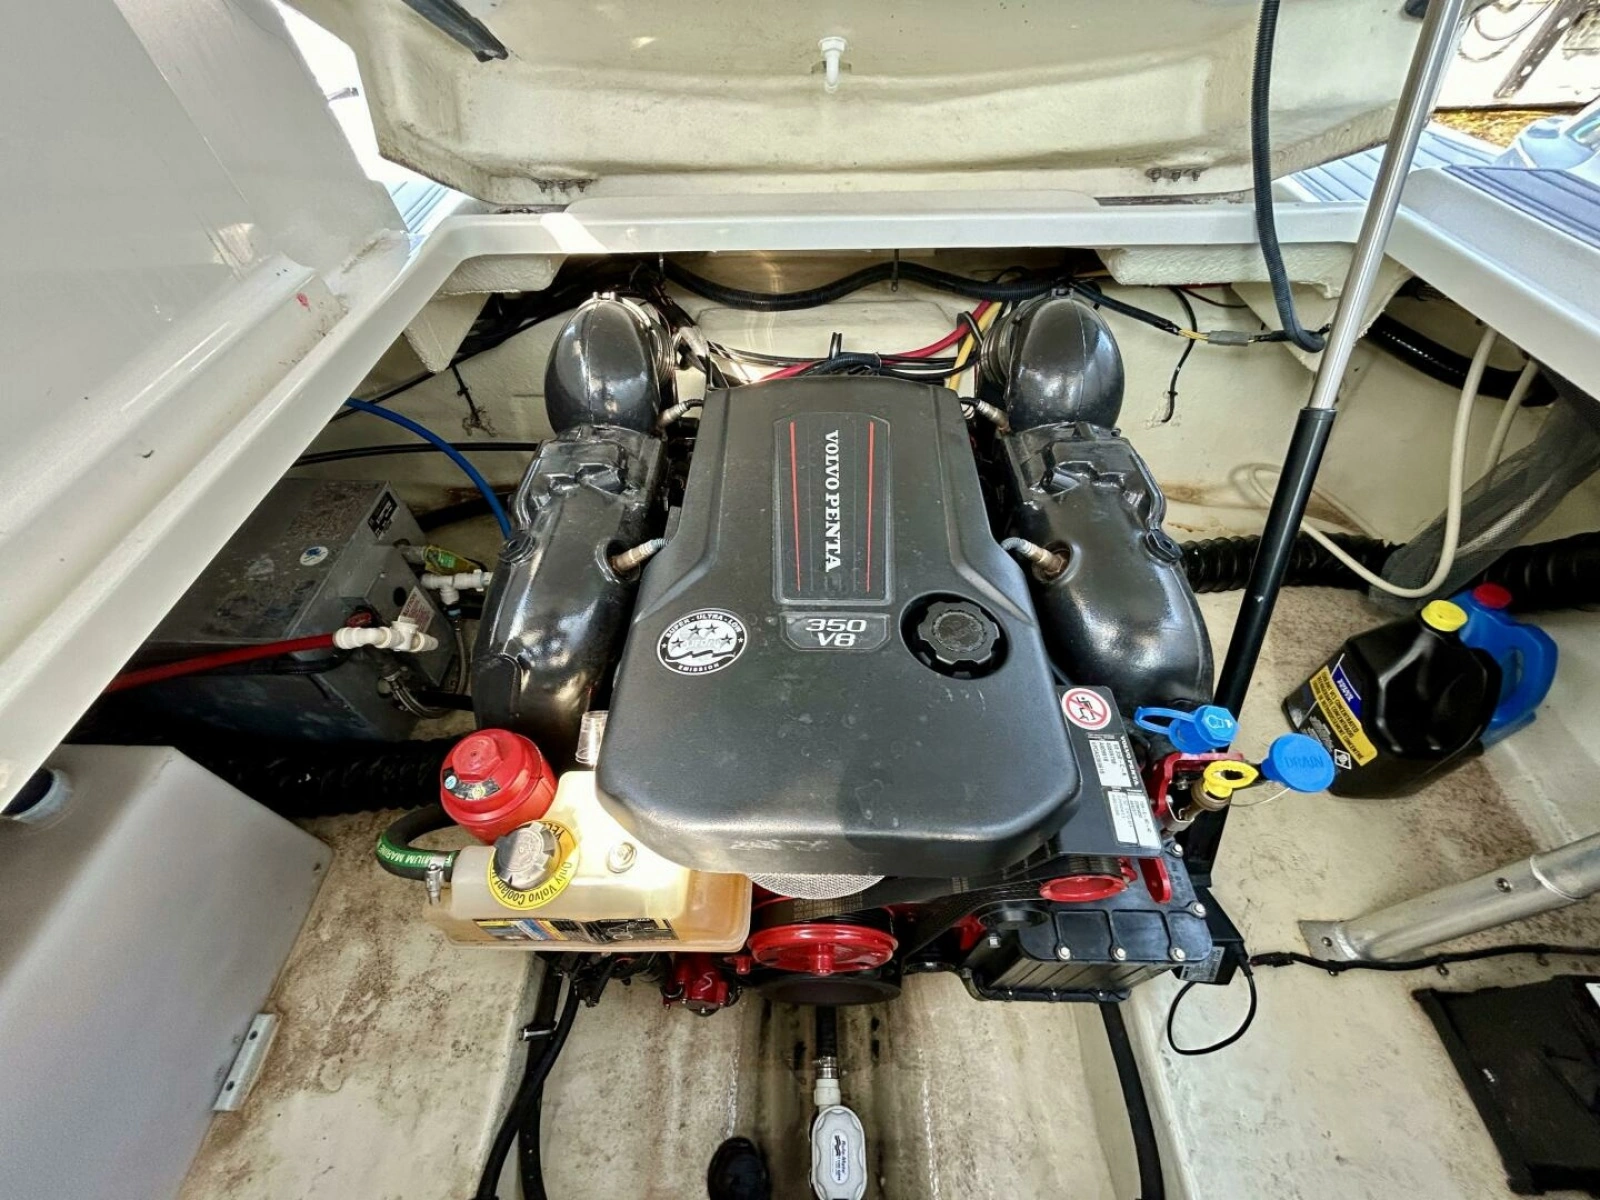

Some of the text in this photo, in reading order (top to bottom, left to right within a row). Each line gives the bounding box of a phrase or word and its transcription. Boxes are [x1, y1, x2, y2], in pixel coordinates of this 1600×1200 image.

[825, 429, 842, 573] VOLVO PENTA
[805, 618, 867, 633] 350
[816, 633, 856, 647] V8
[677, 662, 720, 673] EMISSION
[1120, 735, 1139, 787] VOLVO PENTA
[377, 844, 405, 863] MARINE
[494, 861, 573, 906] Only Volvo Coolant
